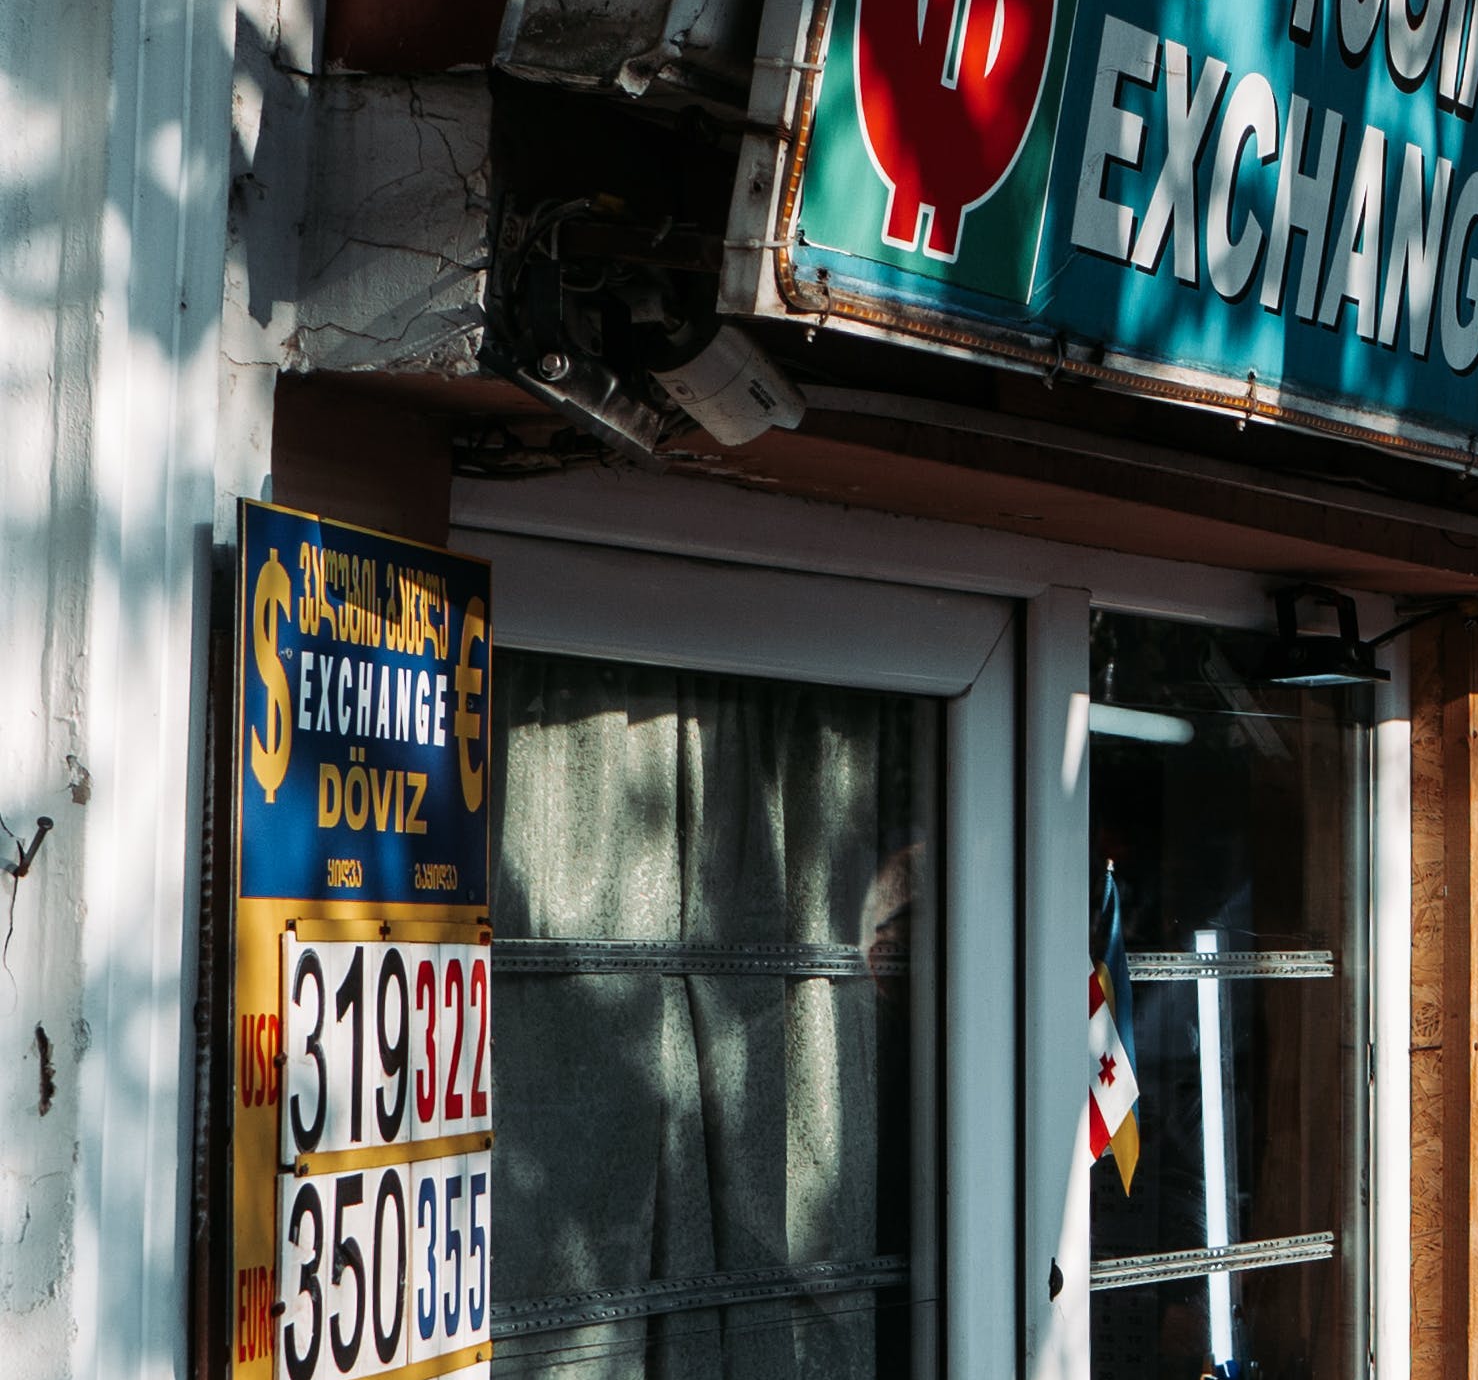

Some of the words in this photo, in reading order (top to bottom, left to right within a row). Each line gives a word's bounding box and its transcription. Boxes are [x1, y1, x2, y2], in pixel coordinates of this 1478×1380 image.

[299, 542, 382, 647] ვალუტის
[386, 563, 449, 660] გაცვლა
[298, 652, 447, 748] EXCHANGE
[318, 747, 428, 834] DÖVIZ
[242, 1014, 278, 1108] USD
